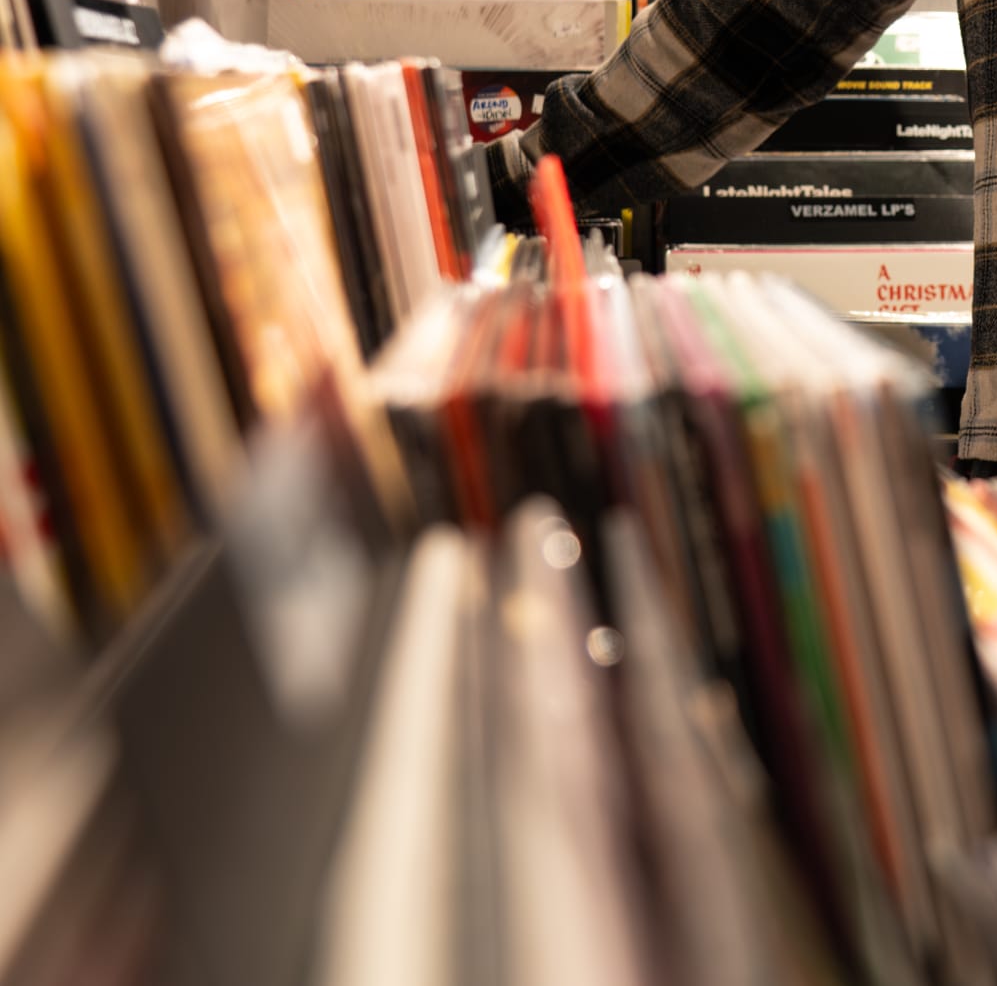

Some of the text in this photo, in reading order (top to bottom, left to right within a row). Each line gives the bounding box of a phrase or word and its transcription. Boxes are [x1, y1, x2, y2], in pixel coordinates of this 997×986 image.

[790, 204, 915, 218] VERZAMEL LP'S
[878, 264, 891, 281] A
